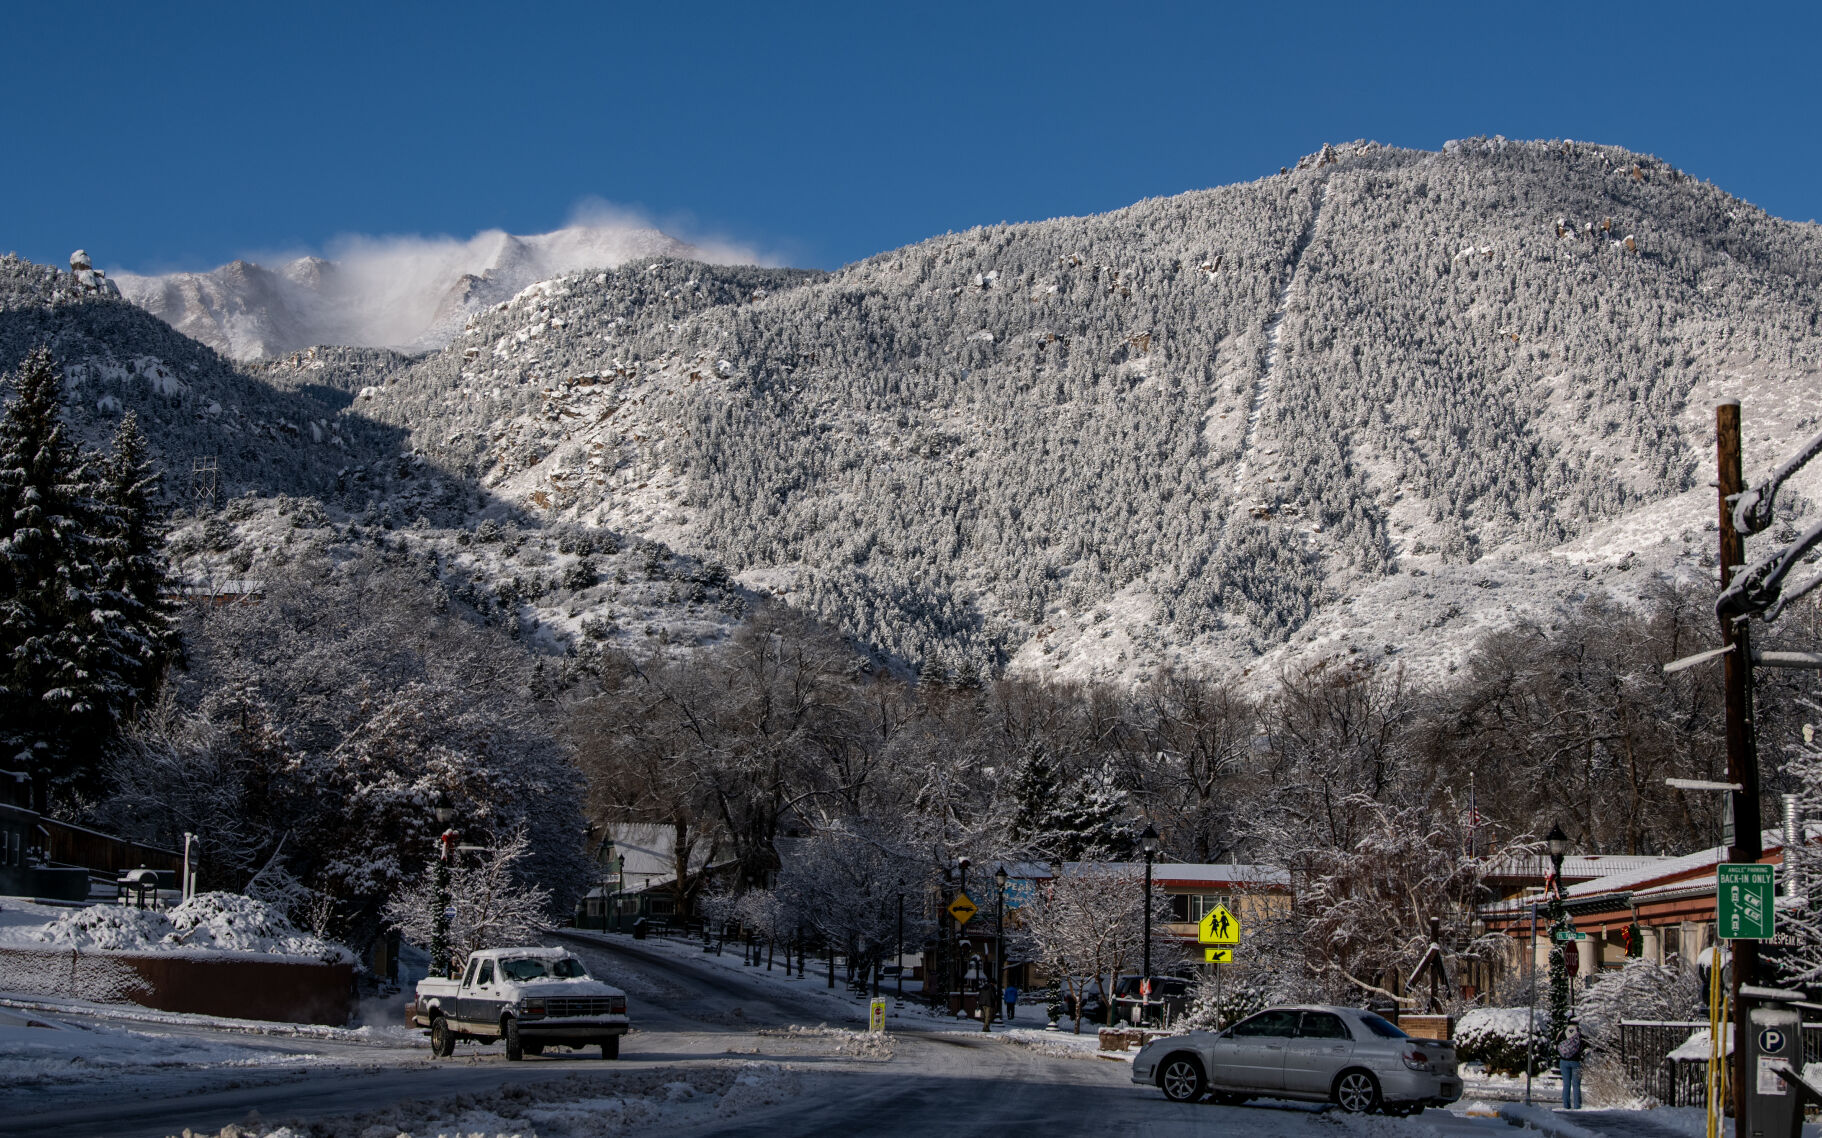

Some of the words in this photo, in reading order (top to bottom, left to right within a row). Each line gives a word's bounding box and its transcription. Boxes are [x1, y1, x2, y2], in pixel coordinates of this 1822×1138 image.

[1720, 874, 1749, 884] BACK-IN
[1752, 874, 1771, 884] ONLY
[1566, 952, 1578, 966] STOP
[1766, 1031, 1780, 1049] P
